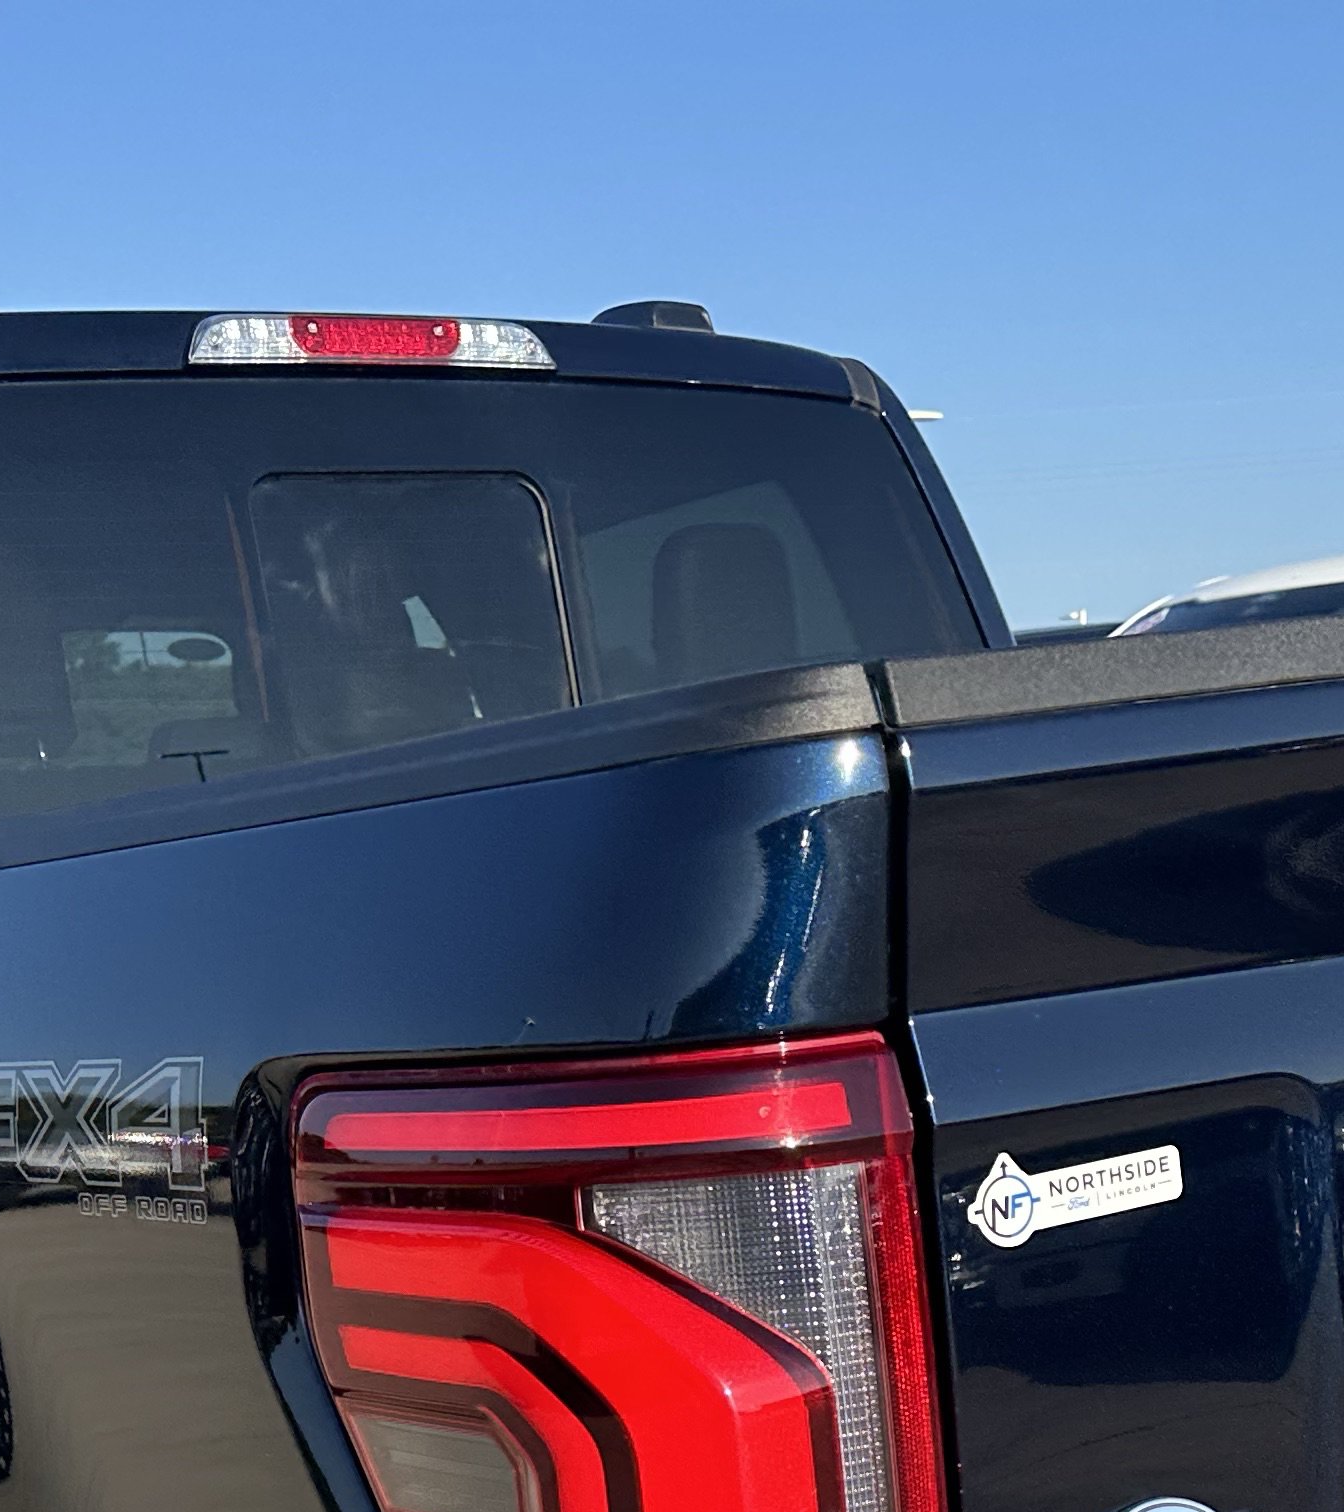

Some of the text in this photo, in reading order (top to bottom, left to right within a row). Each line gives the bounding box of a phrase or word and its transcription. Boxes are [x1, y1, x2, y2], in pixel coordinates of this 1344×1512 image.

[1049, 1156, 1170, 1198] NORTHSIDE
[1106, 1182, 1156, 1200] LINCOLN
[78, 1192, 209, 1225] OFF ROAD
[991, 1191, 1030, 1233] NF
